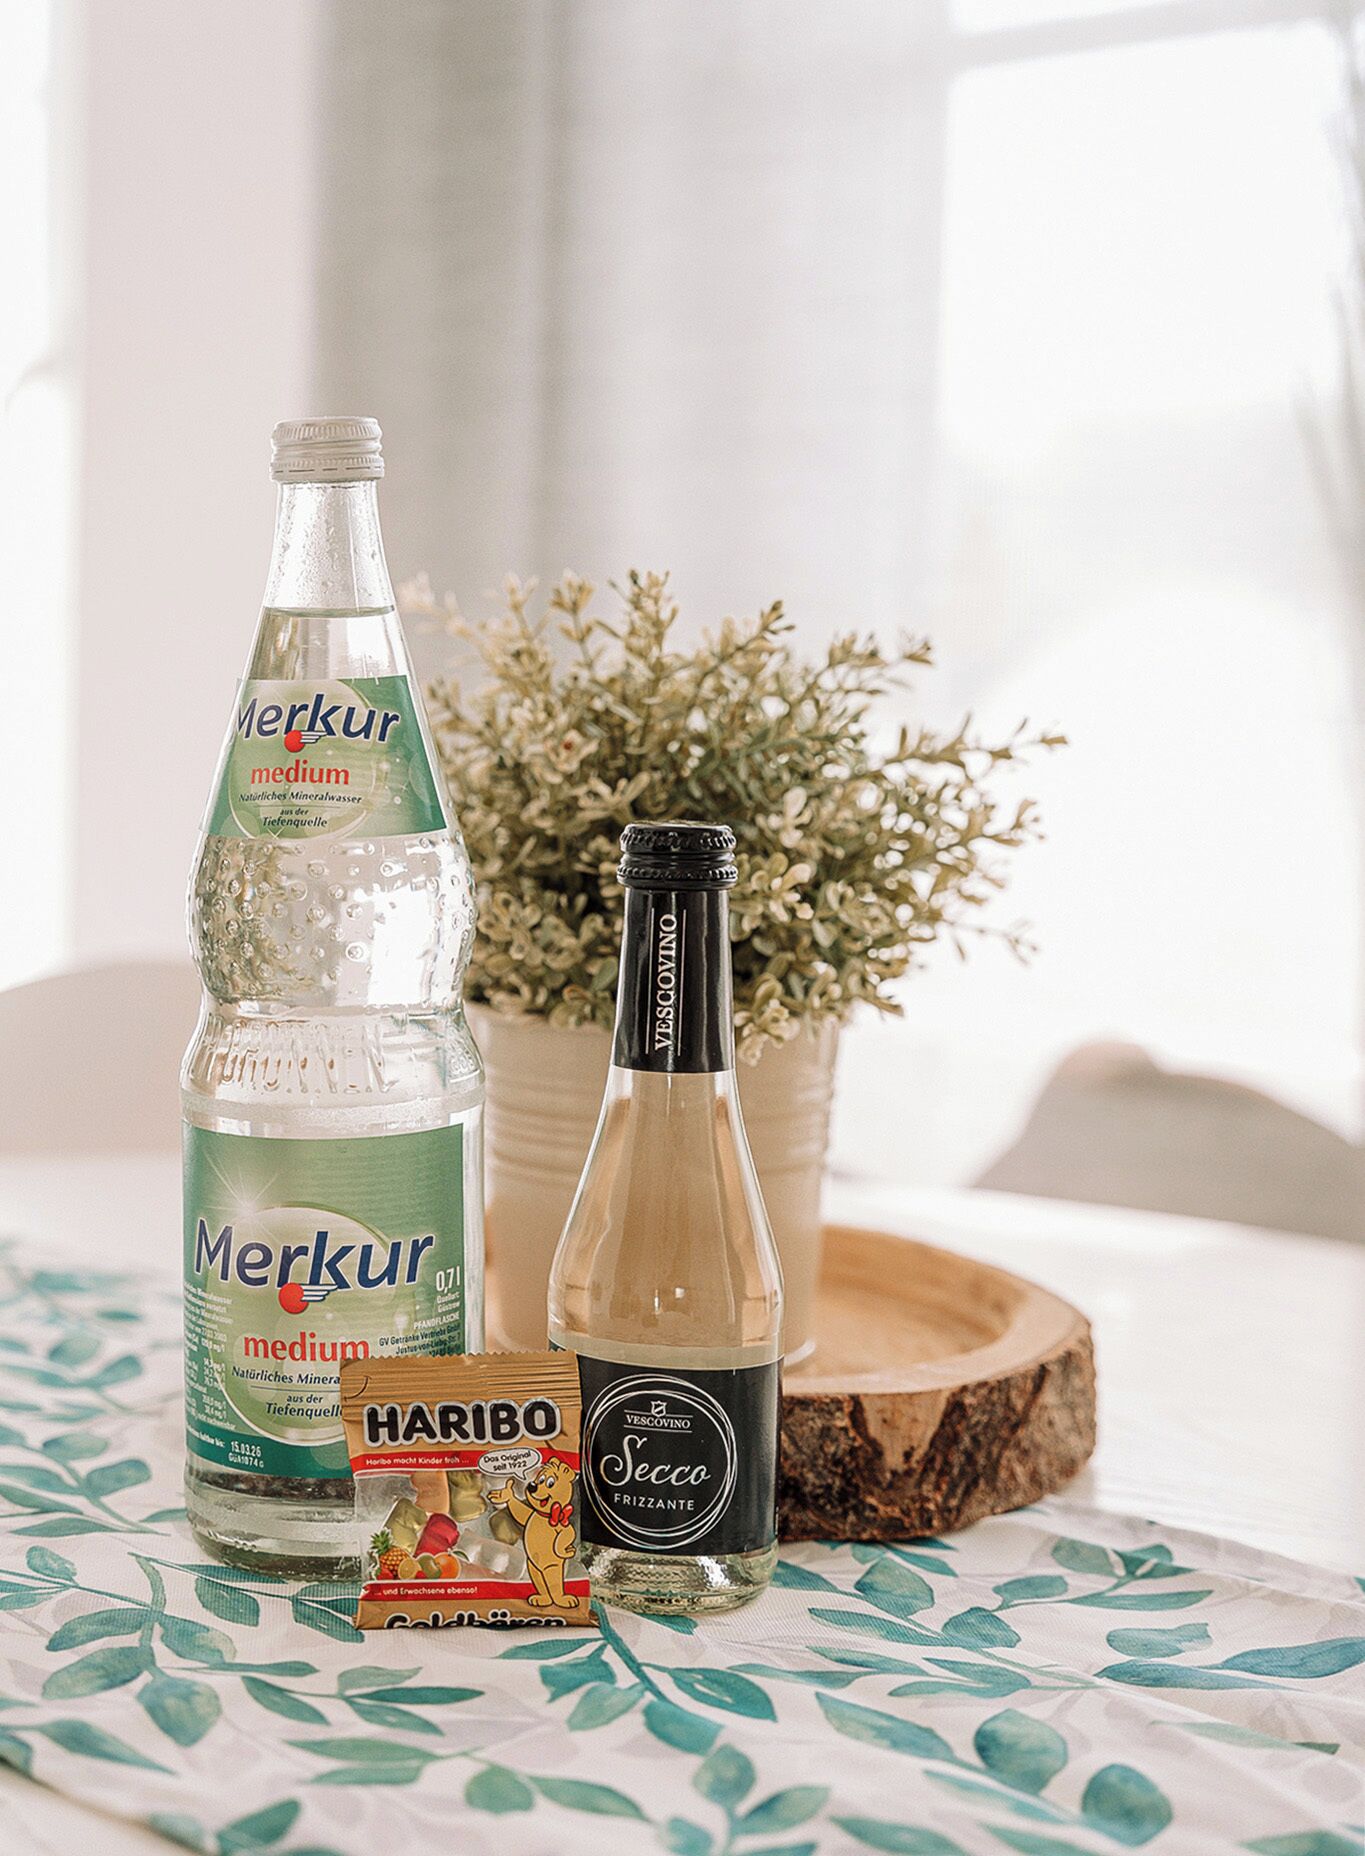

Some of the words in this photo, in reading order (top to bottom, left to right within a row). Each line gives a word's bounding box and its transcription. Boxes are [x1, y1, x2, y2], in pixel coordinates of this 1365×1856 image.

[238, 693, 400, 743] Merkur
[251, 759, 350, 785] medium
[239, 791, 287, 803] Natürliches
[289, 791, 363, 804] Mineralwasser
[295, 808, 309, 816] der
[263, 816, 328, 828] Tiefenquelle
[655, 913, 678, 1051] VESCOVINO
[195, 1218, 434, 1290] Merkur
[243, 1331, 369, 1362] medium
[232, 1366, 293, 1384] Natürliches
[297, 1373, 340, 1385] Minera
[287, 1395, 303, 1404] aus
[305, 1394, 323, 1404] der
[366, 1400, 559, 1443] HARIBO
[625, 1414, 691, 1429] VESCOVINO
[231, 1441, 262, 1457] 15.03.26
[484, 1455, 501, 1464] Das
[502, 1450, 532, 1463] Original
[366, 1458, 392, 1466] Haribo
[394, 1457, 417, 1465] macht
[418, 1456, 443, 1465] Kinder
[444, 1456, 460, 1464] froh
[493, 1463, 508, 1472] seit
[509, 1461, 527, 1470] 1922
[600, 1434, 711, 1487] Secco
[614, 1493, 695, 1511] FRIZZANTE
[383, 1587, 399, 1595] und
[400, 1587, 445, 1595] Erwachsene
[447, 1586, 478, 1595] ebenso!
